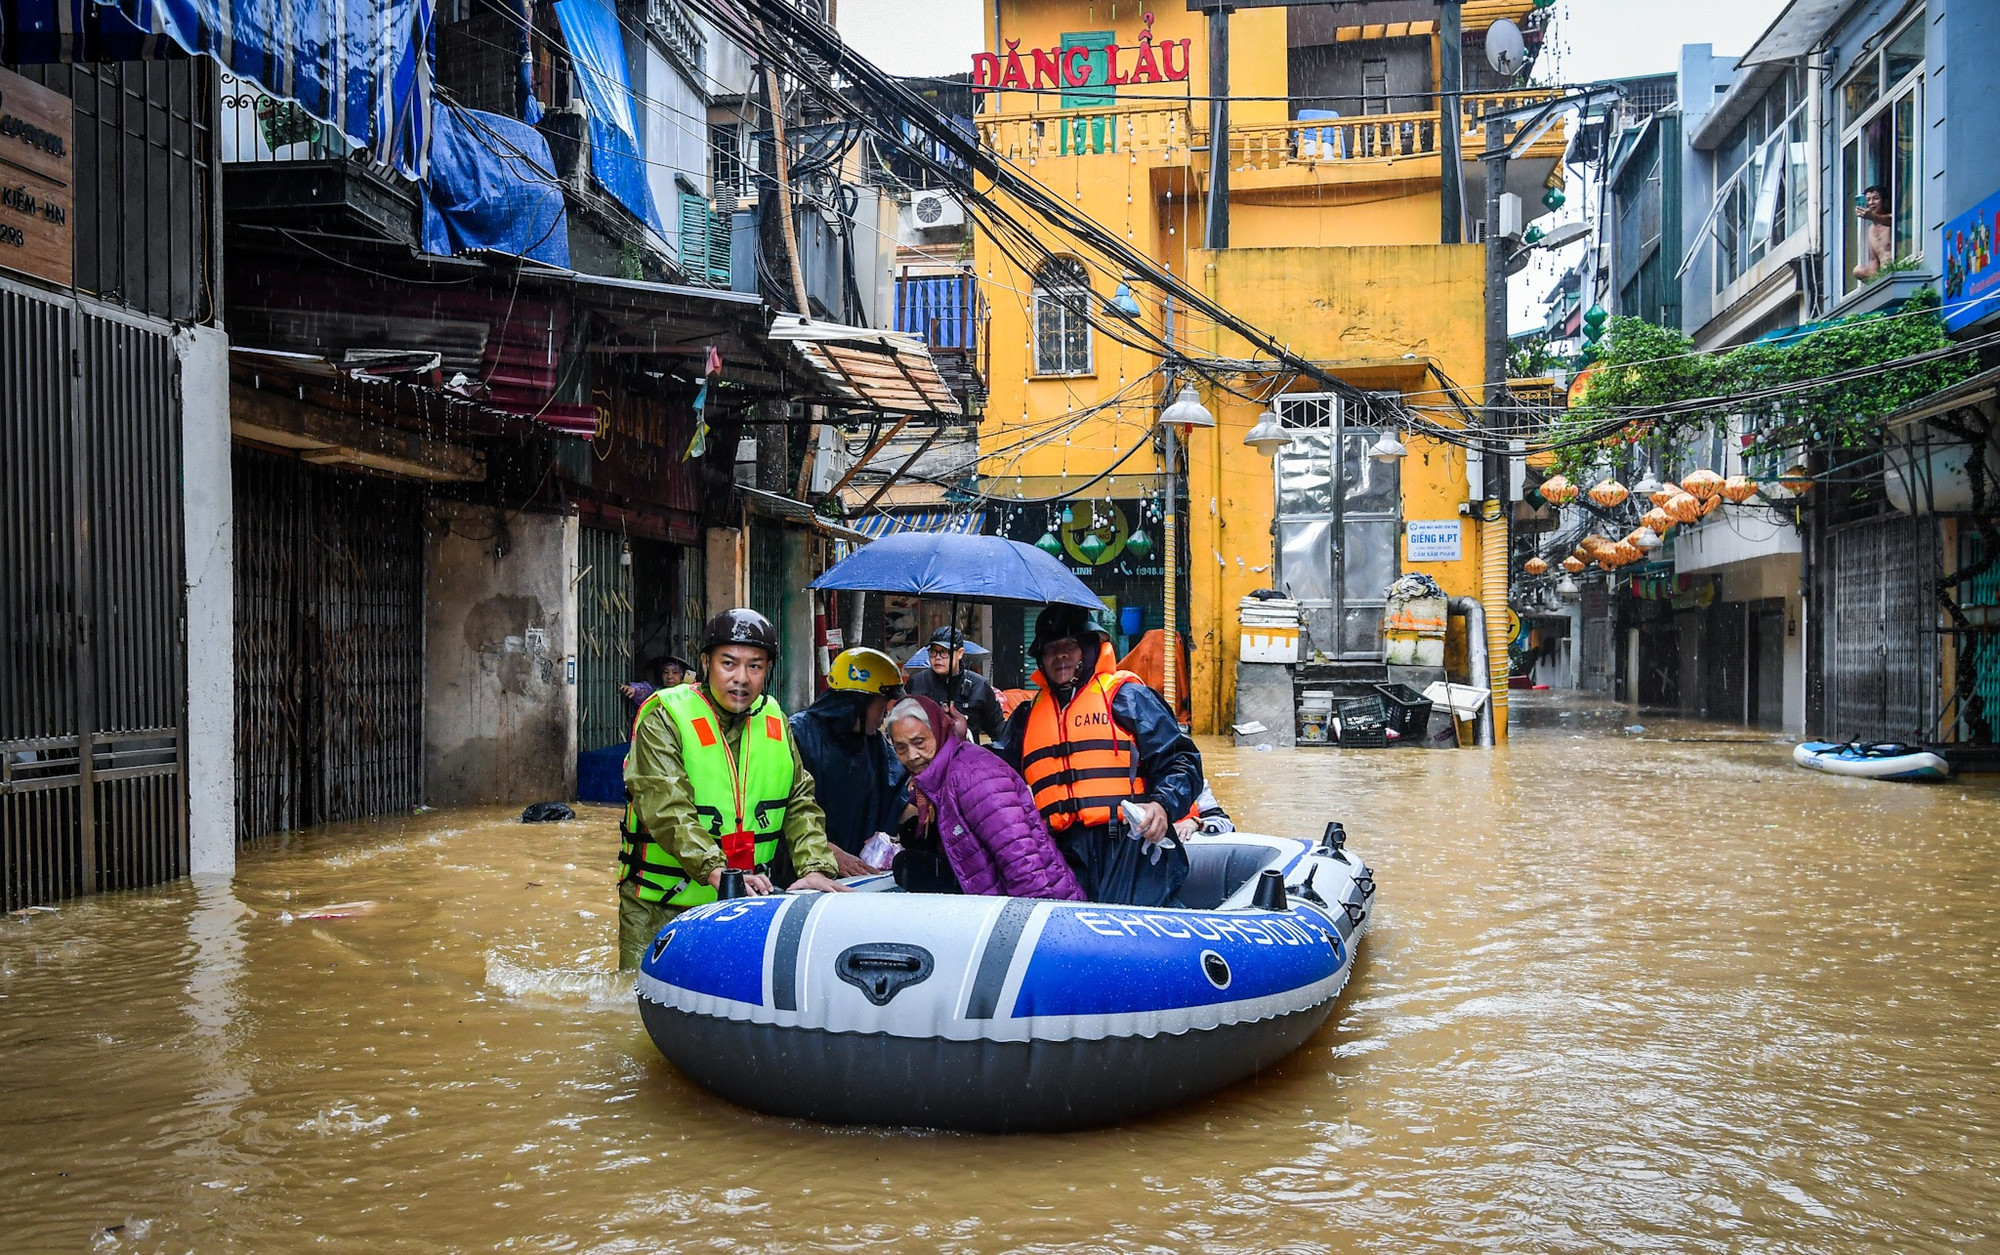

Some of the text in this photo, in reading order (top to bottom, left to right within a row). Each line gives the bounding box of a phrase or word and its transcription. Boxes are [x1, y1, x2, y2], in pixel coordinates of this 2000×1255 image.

[971, 11, 1191, 93] ĐĂNG LẨU
[1411, 531, 1458, 543] GIẾNG H.PT
[1071, 567, 1093, 576] LINH
[848, 663, 871, 683] be
[1074, 712, 1110, 728] CAND
[1074, 912, 1315, 946] EXCURSION
